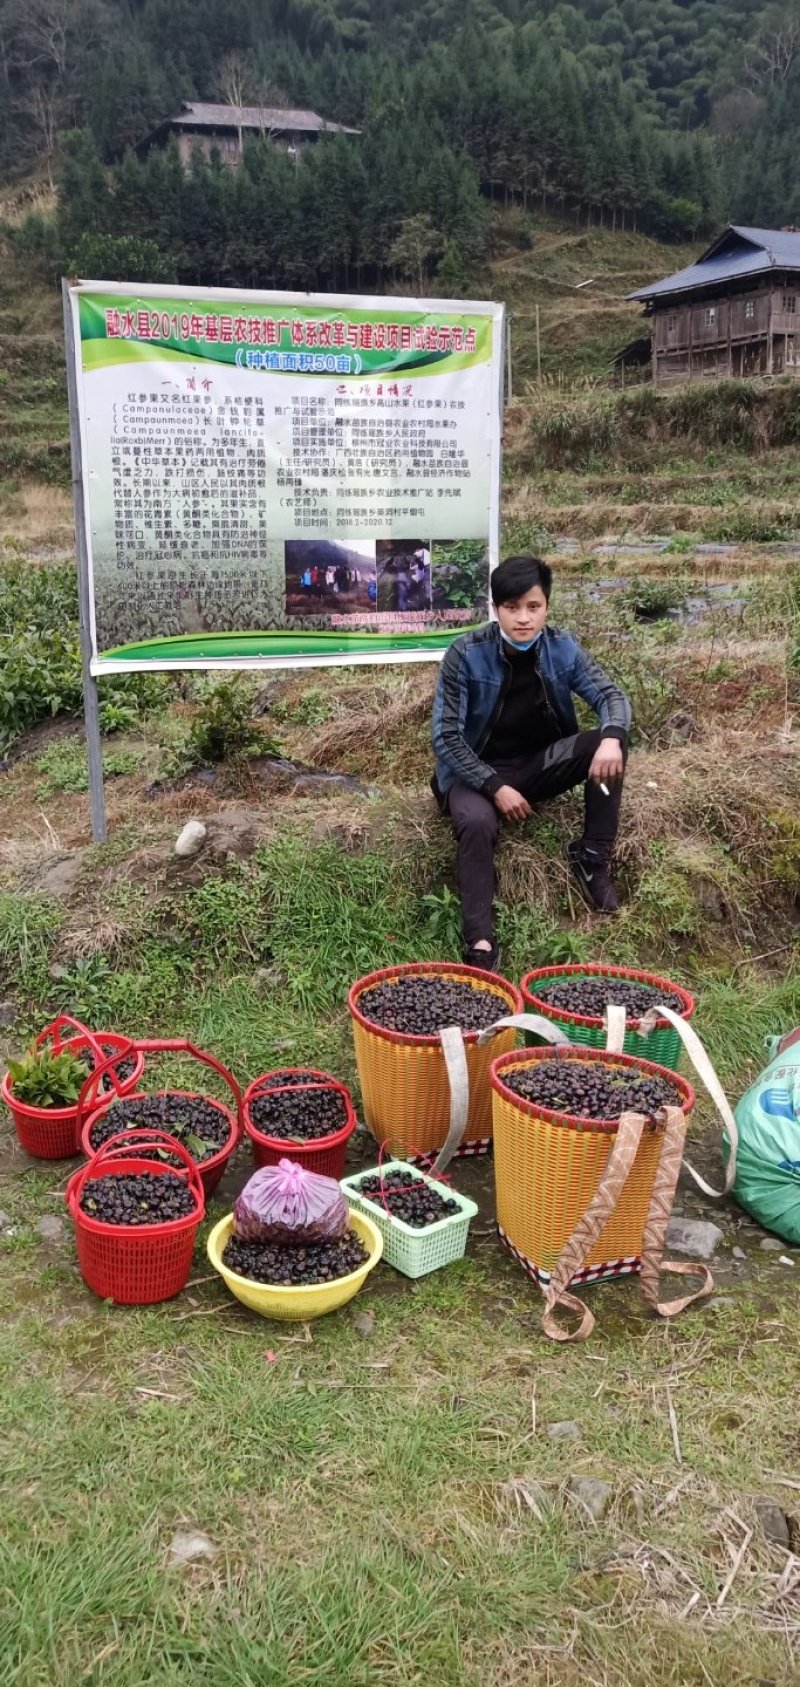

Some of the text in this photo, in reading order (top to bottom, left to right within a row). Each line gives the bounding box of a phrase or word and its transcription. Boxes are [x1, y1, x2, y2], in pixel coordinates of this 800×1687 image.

[105, 309, 477, 352] 融水县2019年基层农技推广体系改革与建设项目试验示范点
[235, 347, 362, 374] （种植面积50亩）
[335, 384, 414, 397] 二、项目情况
